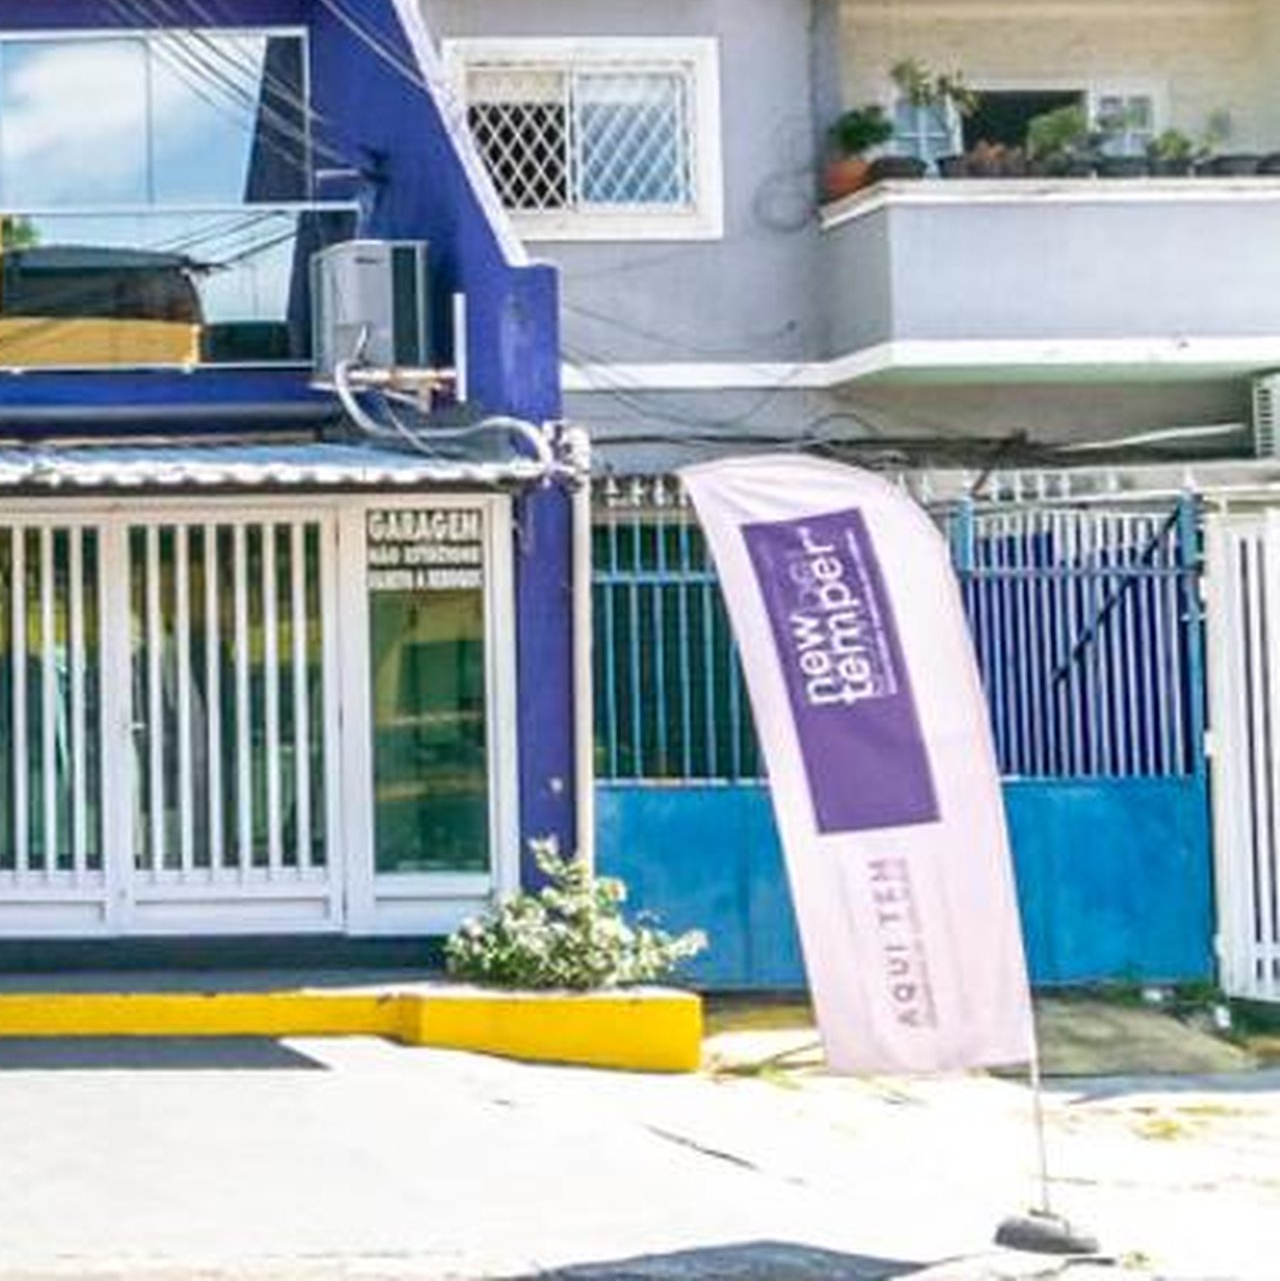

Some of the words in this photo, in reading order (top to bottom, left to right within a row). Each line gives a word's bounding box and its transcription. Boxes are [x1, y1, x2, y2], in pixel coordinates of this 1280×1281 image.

[368, 511, 480, 540] GARAGEM
[797, 526, 874, 705] temper
[791, 615, 840, 705] new
[882, 945, 920, 1029] AQUI
